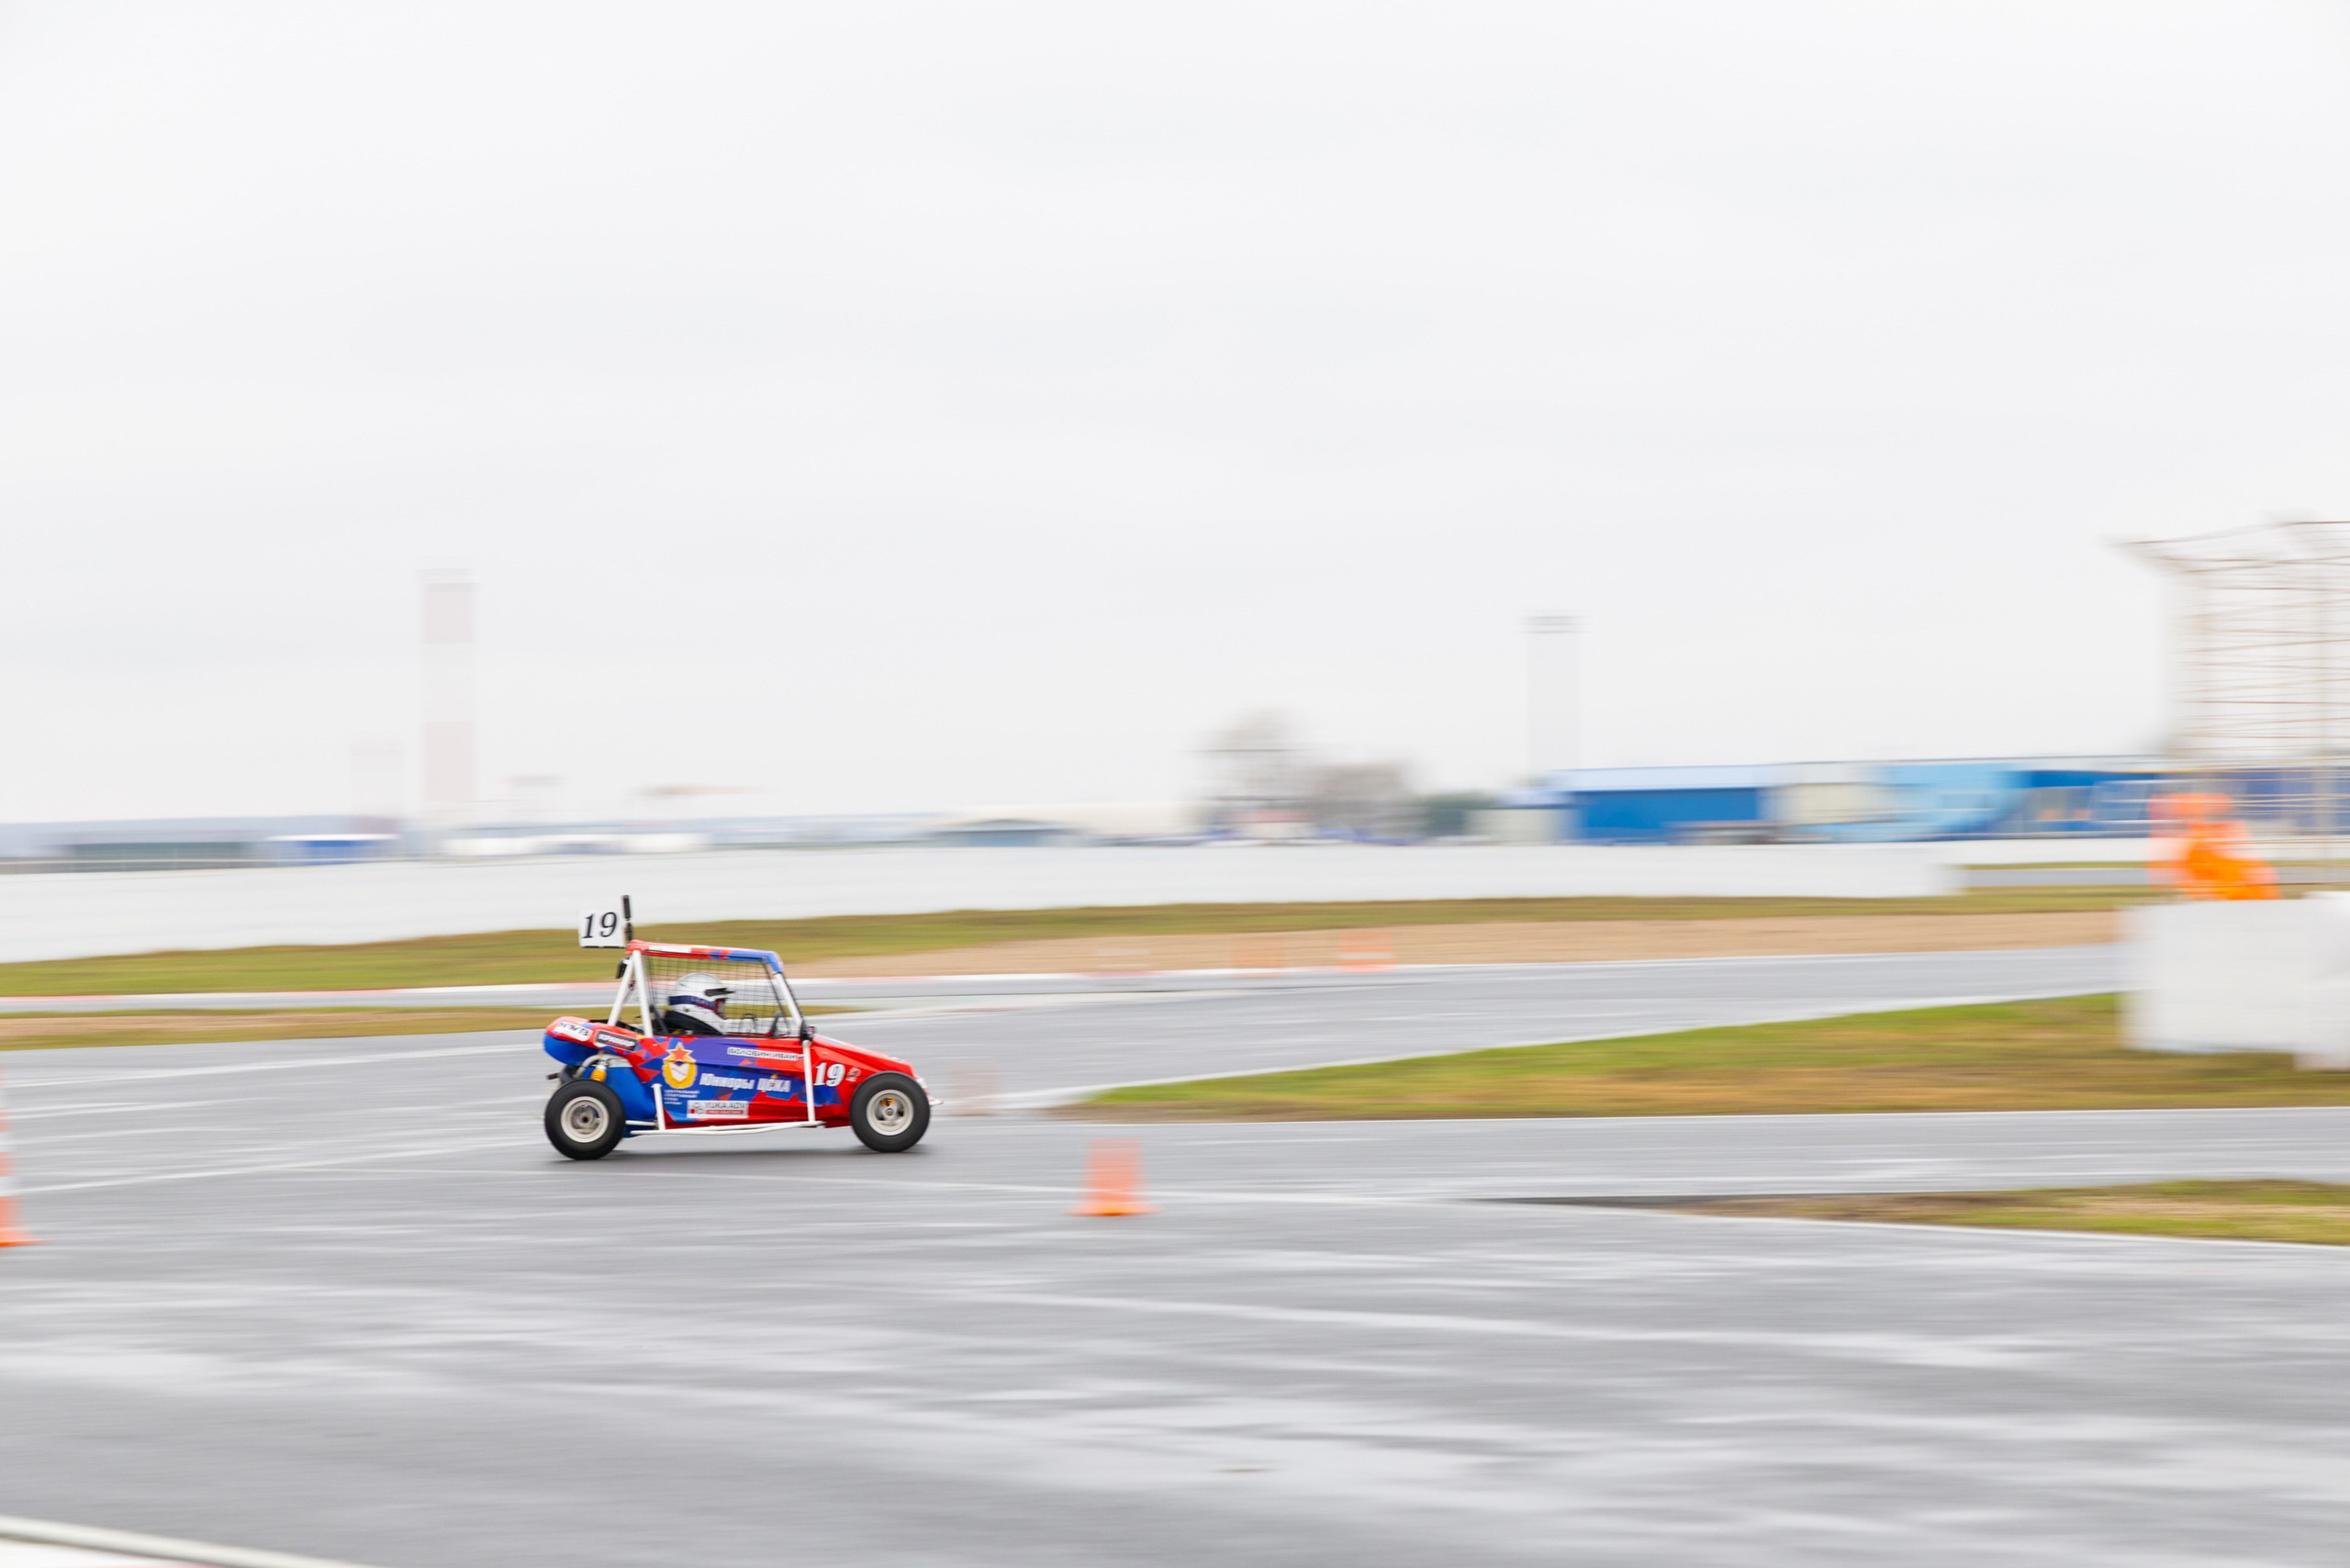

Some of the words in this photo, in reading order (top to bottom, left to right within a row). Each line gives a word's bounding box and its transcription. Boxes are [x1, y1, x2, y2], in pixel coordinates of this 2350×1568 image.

[581, 912, 618, 938] 19
[699, 1073, 755, 1090] Юниоры
[756, 1078, 792, 1092] ЦСКА
[812, 1062, 846, 1088] 19
